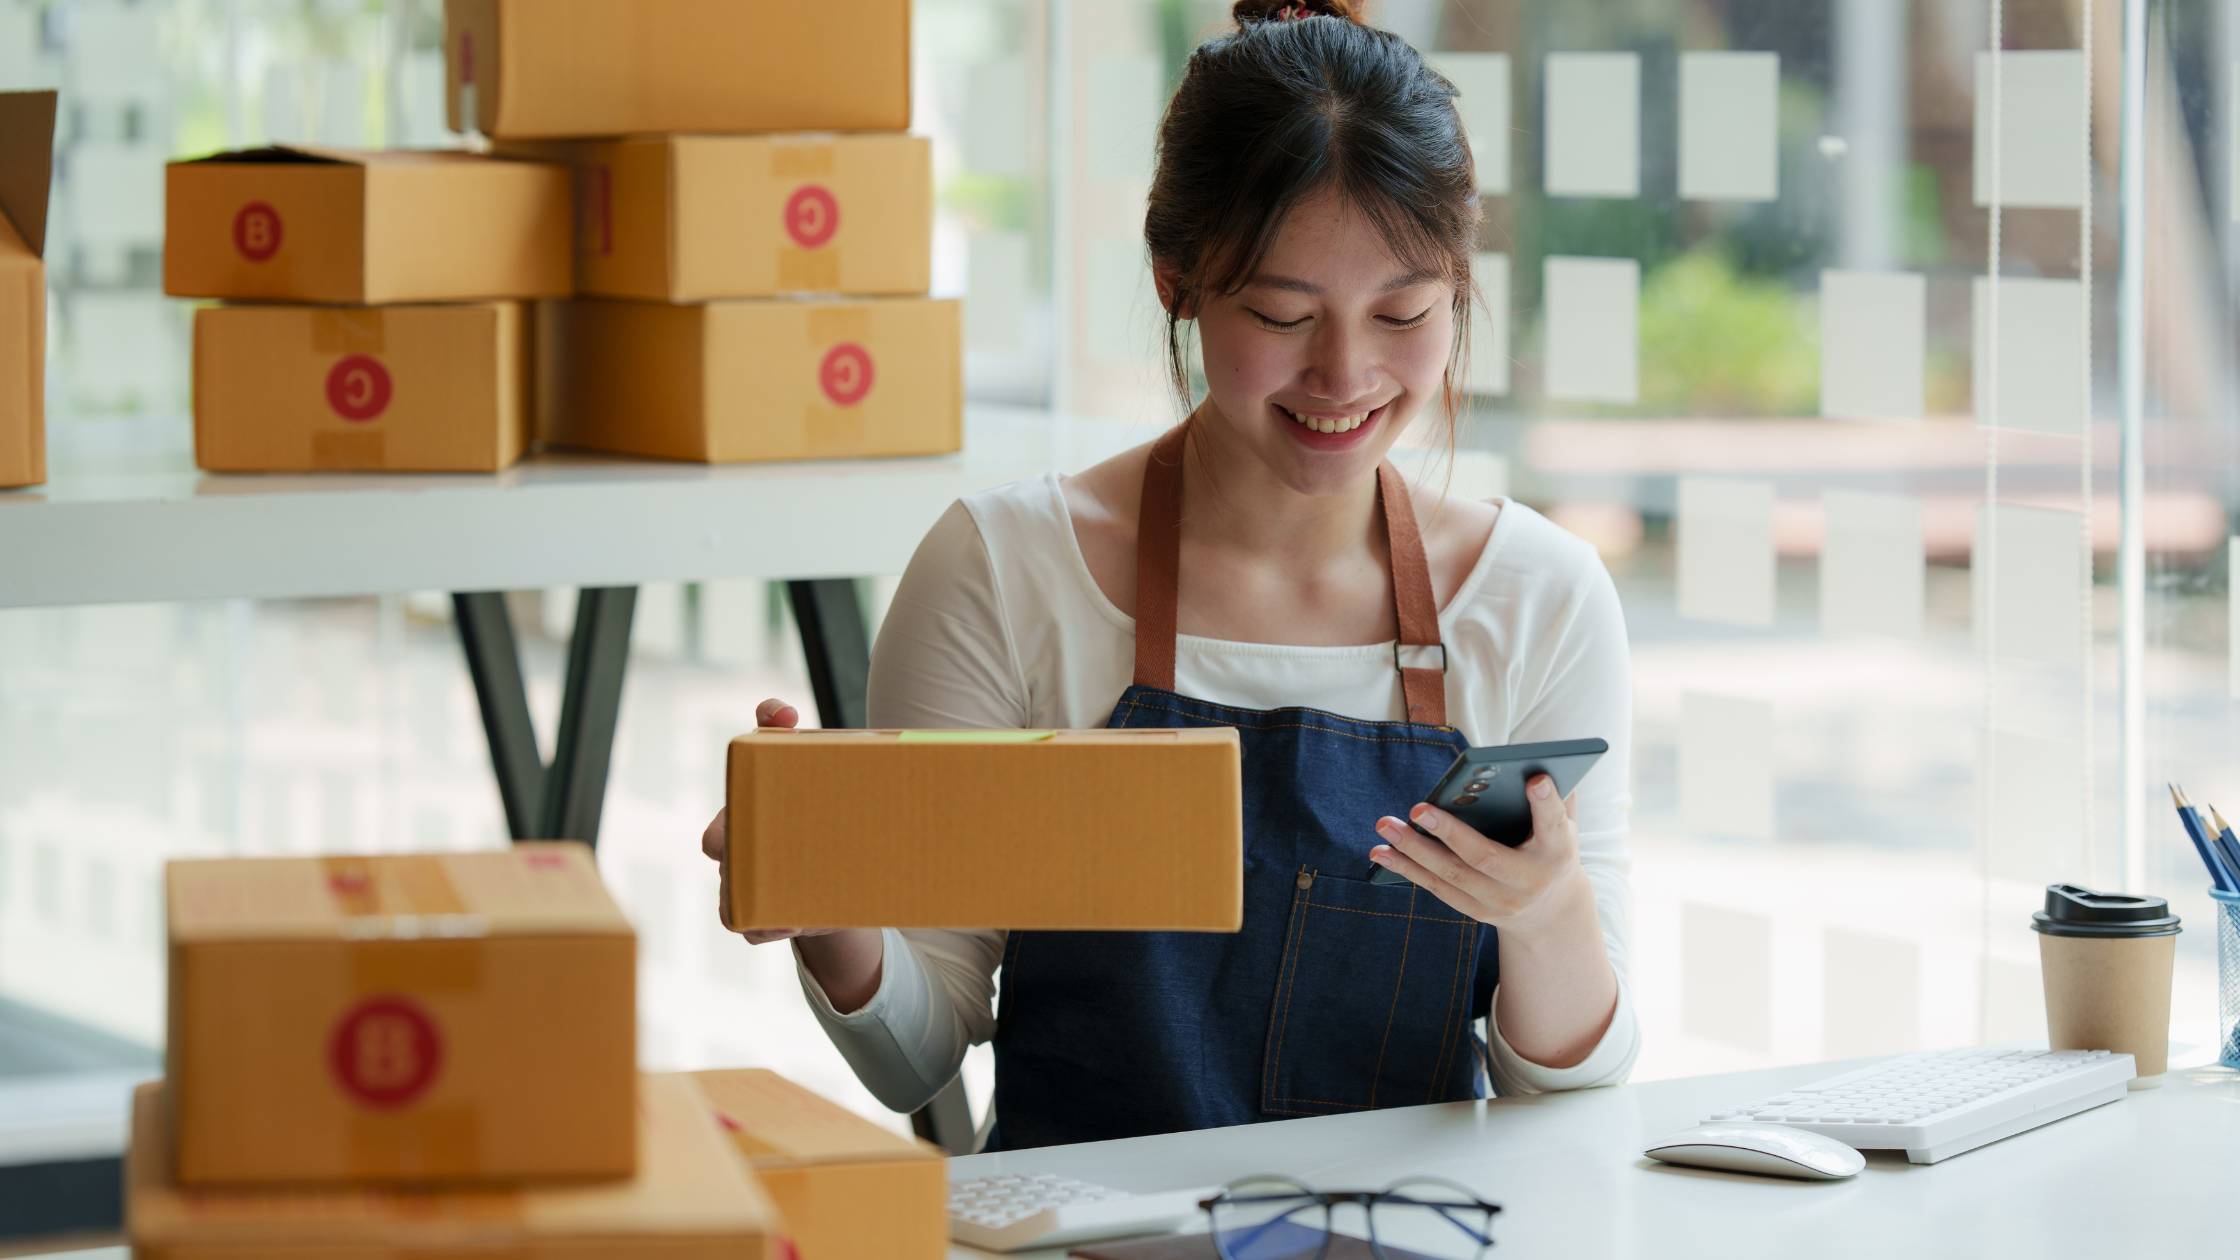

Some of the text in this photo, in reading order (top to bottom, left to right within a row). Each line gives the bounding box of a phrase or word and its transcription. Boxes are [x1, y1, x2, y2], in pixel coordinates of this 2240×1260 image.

[245, 212, 271, 249] B
[797, 197, 826, 236] C
[343, 368, 374, 408] C
[833, 354, 861, 394] C
